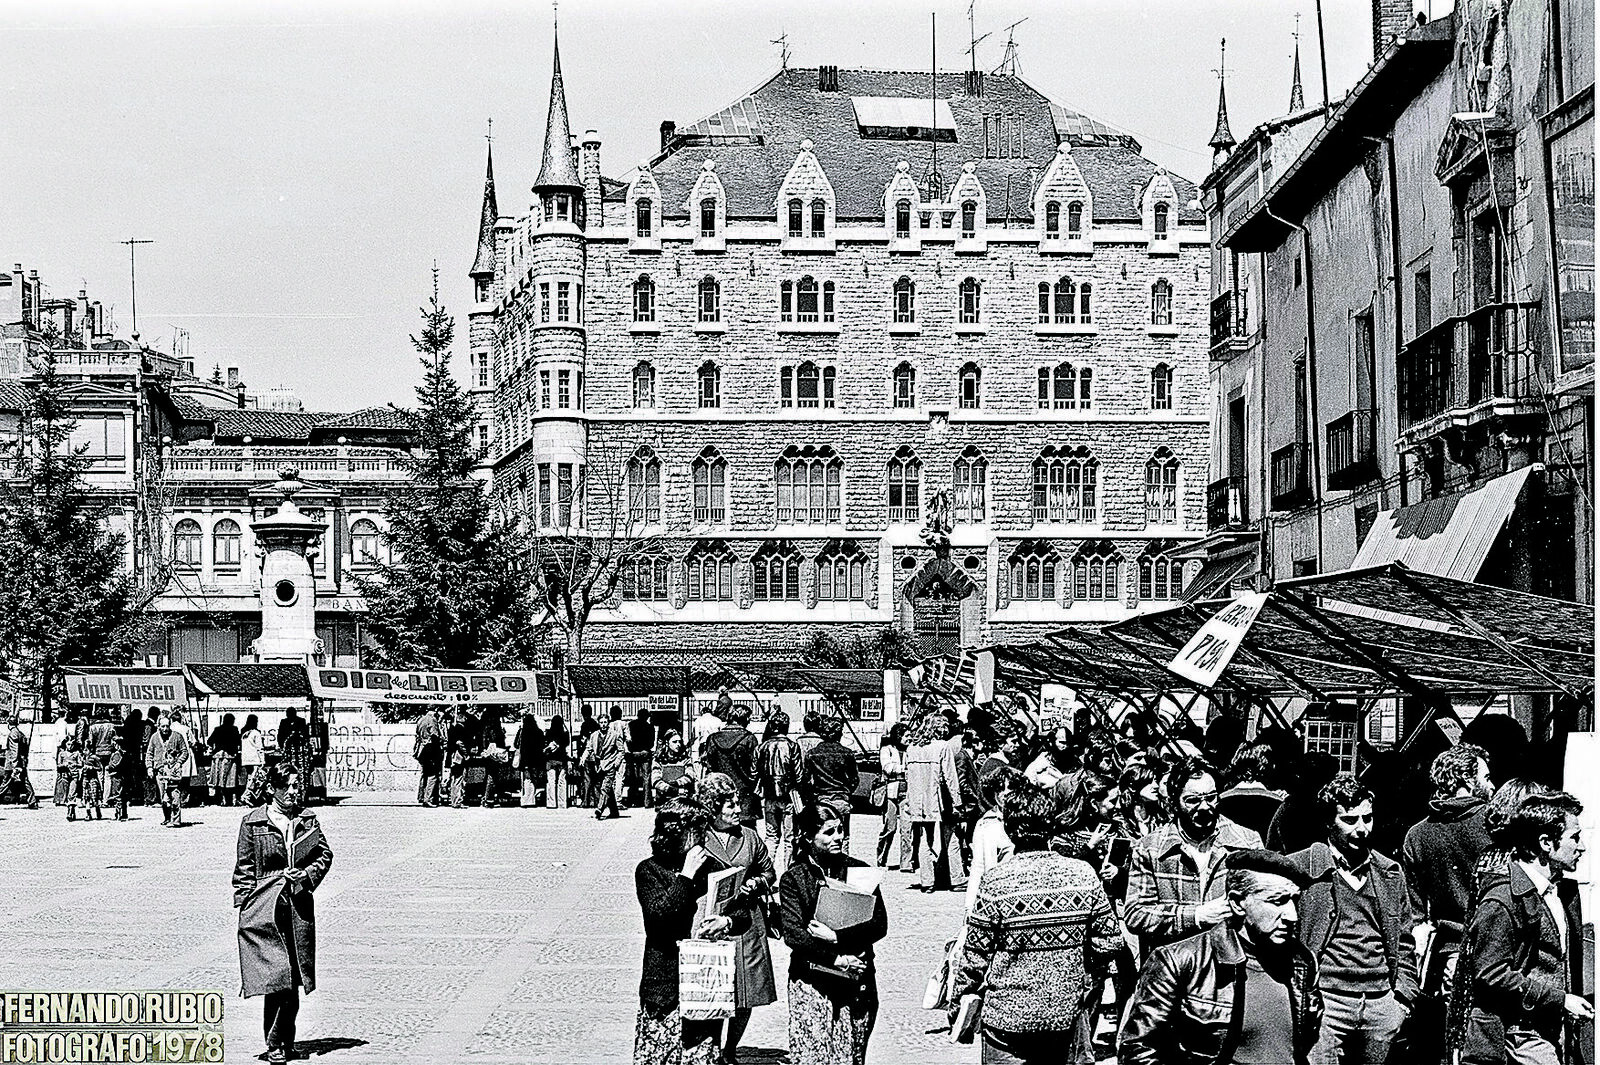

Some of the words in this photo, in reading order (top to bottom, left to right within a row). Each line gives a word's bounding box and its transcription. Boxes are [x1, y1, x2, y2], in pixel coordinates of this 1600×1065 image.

[78, 677, 112, 699] don
[117, 678, 176, 701] bosco
[319, 670, 392, 689] DIA
[391, 676, 409, 690] del
[409, 674, 527, 692] LIBRO
